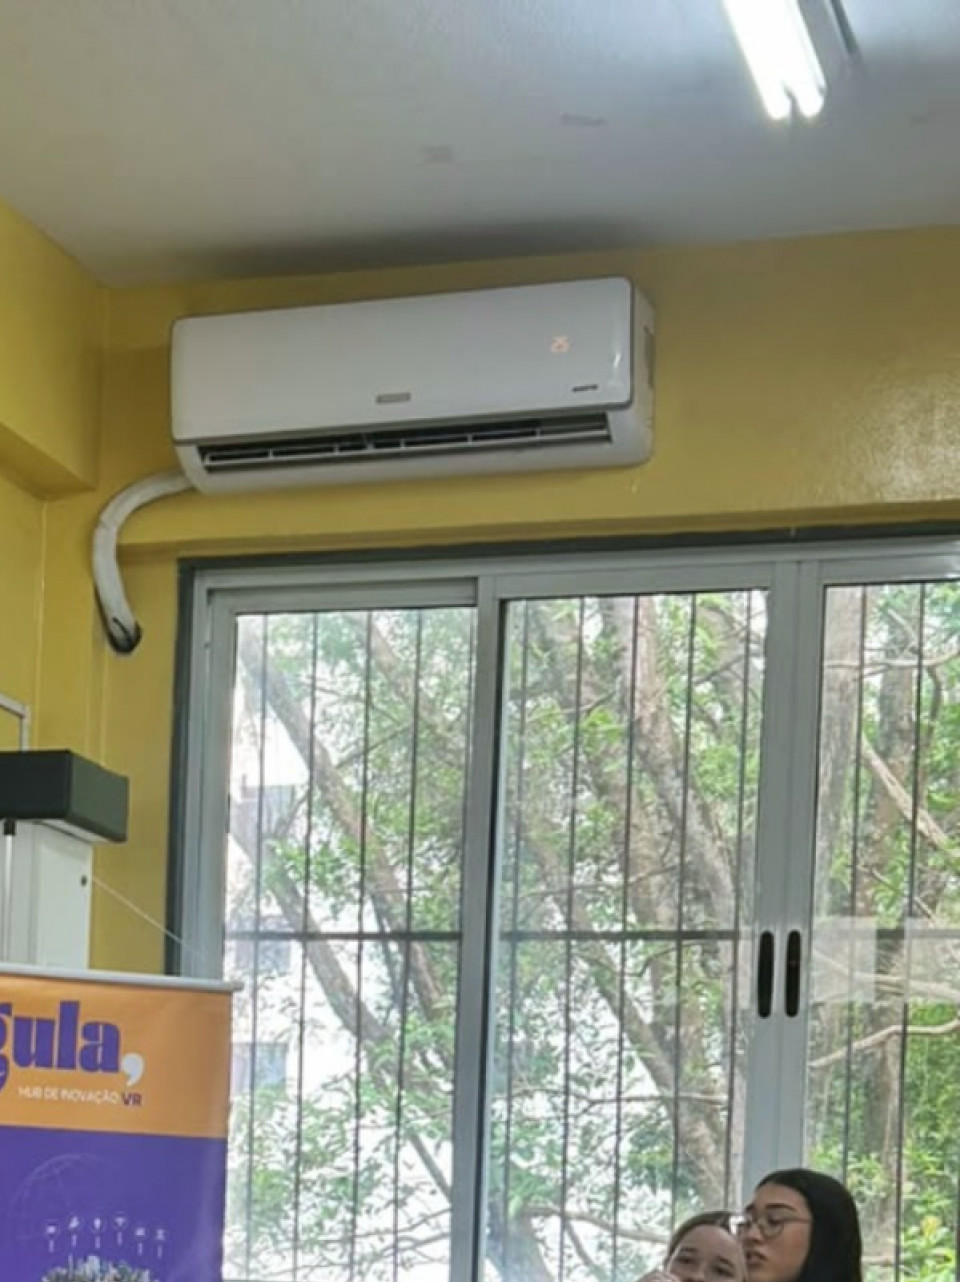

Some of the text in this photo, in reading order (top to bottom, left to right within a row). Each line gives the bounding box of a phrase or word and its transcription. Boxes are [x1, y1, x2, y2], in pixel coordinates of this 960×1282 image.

[18, 1087, 43, 1099] HUB
[44, 1088, 58, 1100] DE
[122, 1092, 143, 1106] VR
